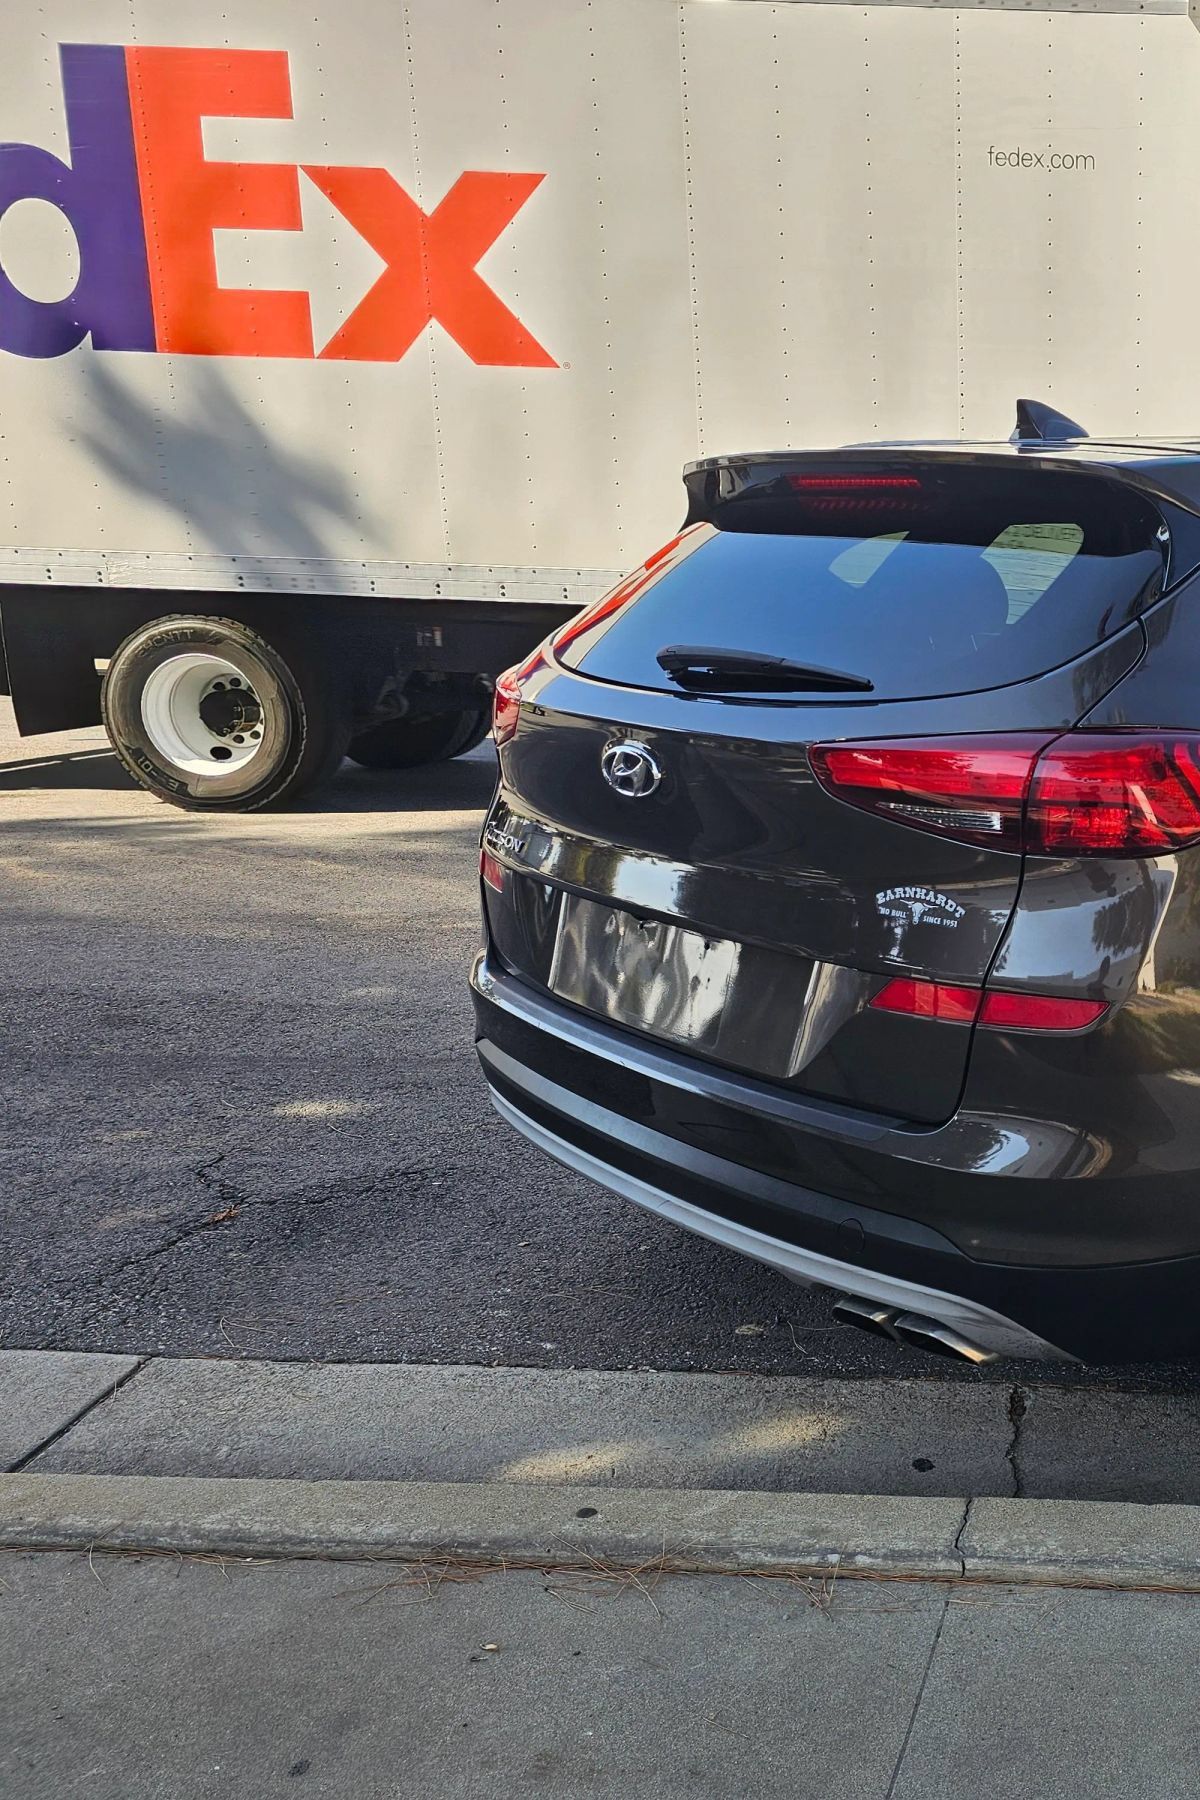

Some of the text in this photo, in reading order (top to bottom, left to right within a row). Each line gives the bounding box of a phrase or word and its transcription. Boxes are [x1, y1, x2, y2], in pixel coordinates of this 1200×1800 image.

[986, 145, 1095, 171] fedex.com
[875, 887, 966, 918] EARNHARDT
[922, 915, 942, 925] SINCE
